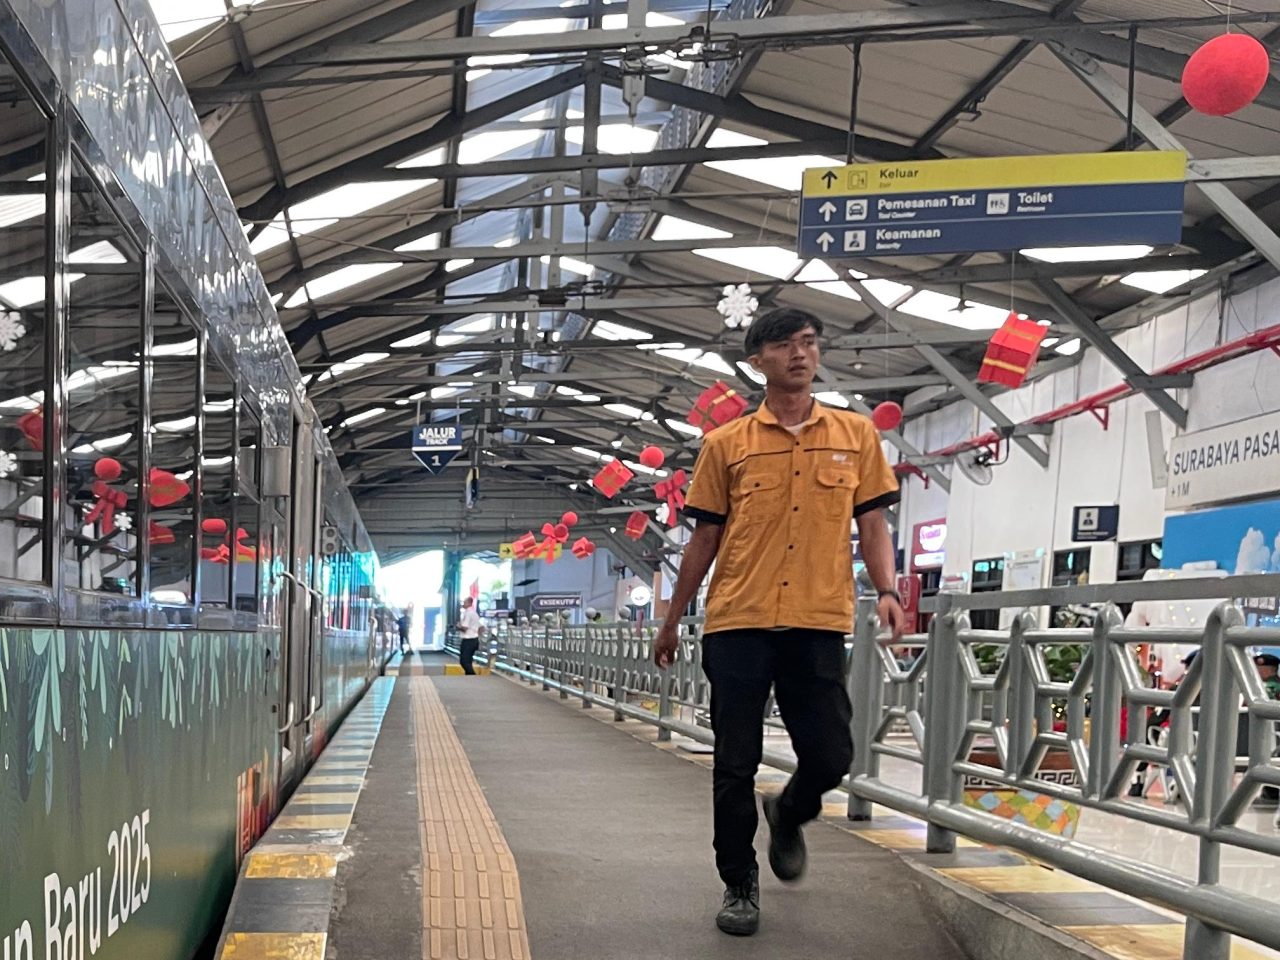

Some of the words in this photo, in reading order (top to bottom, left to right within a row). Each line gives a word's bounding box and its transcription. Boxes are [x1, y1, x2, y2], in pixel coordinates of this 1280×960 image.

[879, 168, 919, 179] Keluar
[877, 198, 948, 210] Pemesanan
[950, 194, 976, 207] Taxi
[1017, 192, 1053, 204] Toilet
[876, 228, 941, 240] Keamanan
[419, 427, 456, 439] JALUR
[431, 455, 441, 466] 1
[1173, 440, 1240, 476] SURABAYA
[107, 808, 151, 938] 2025
